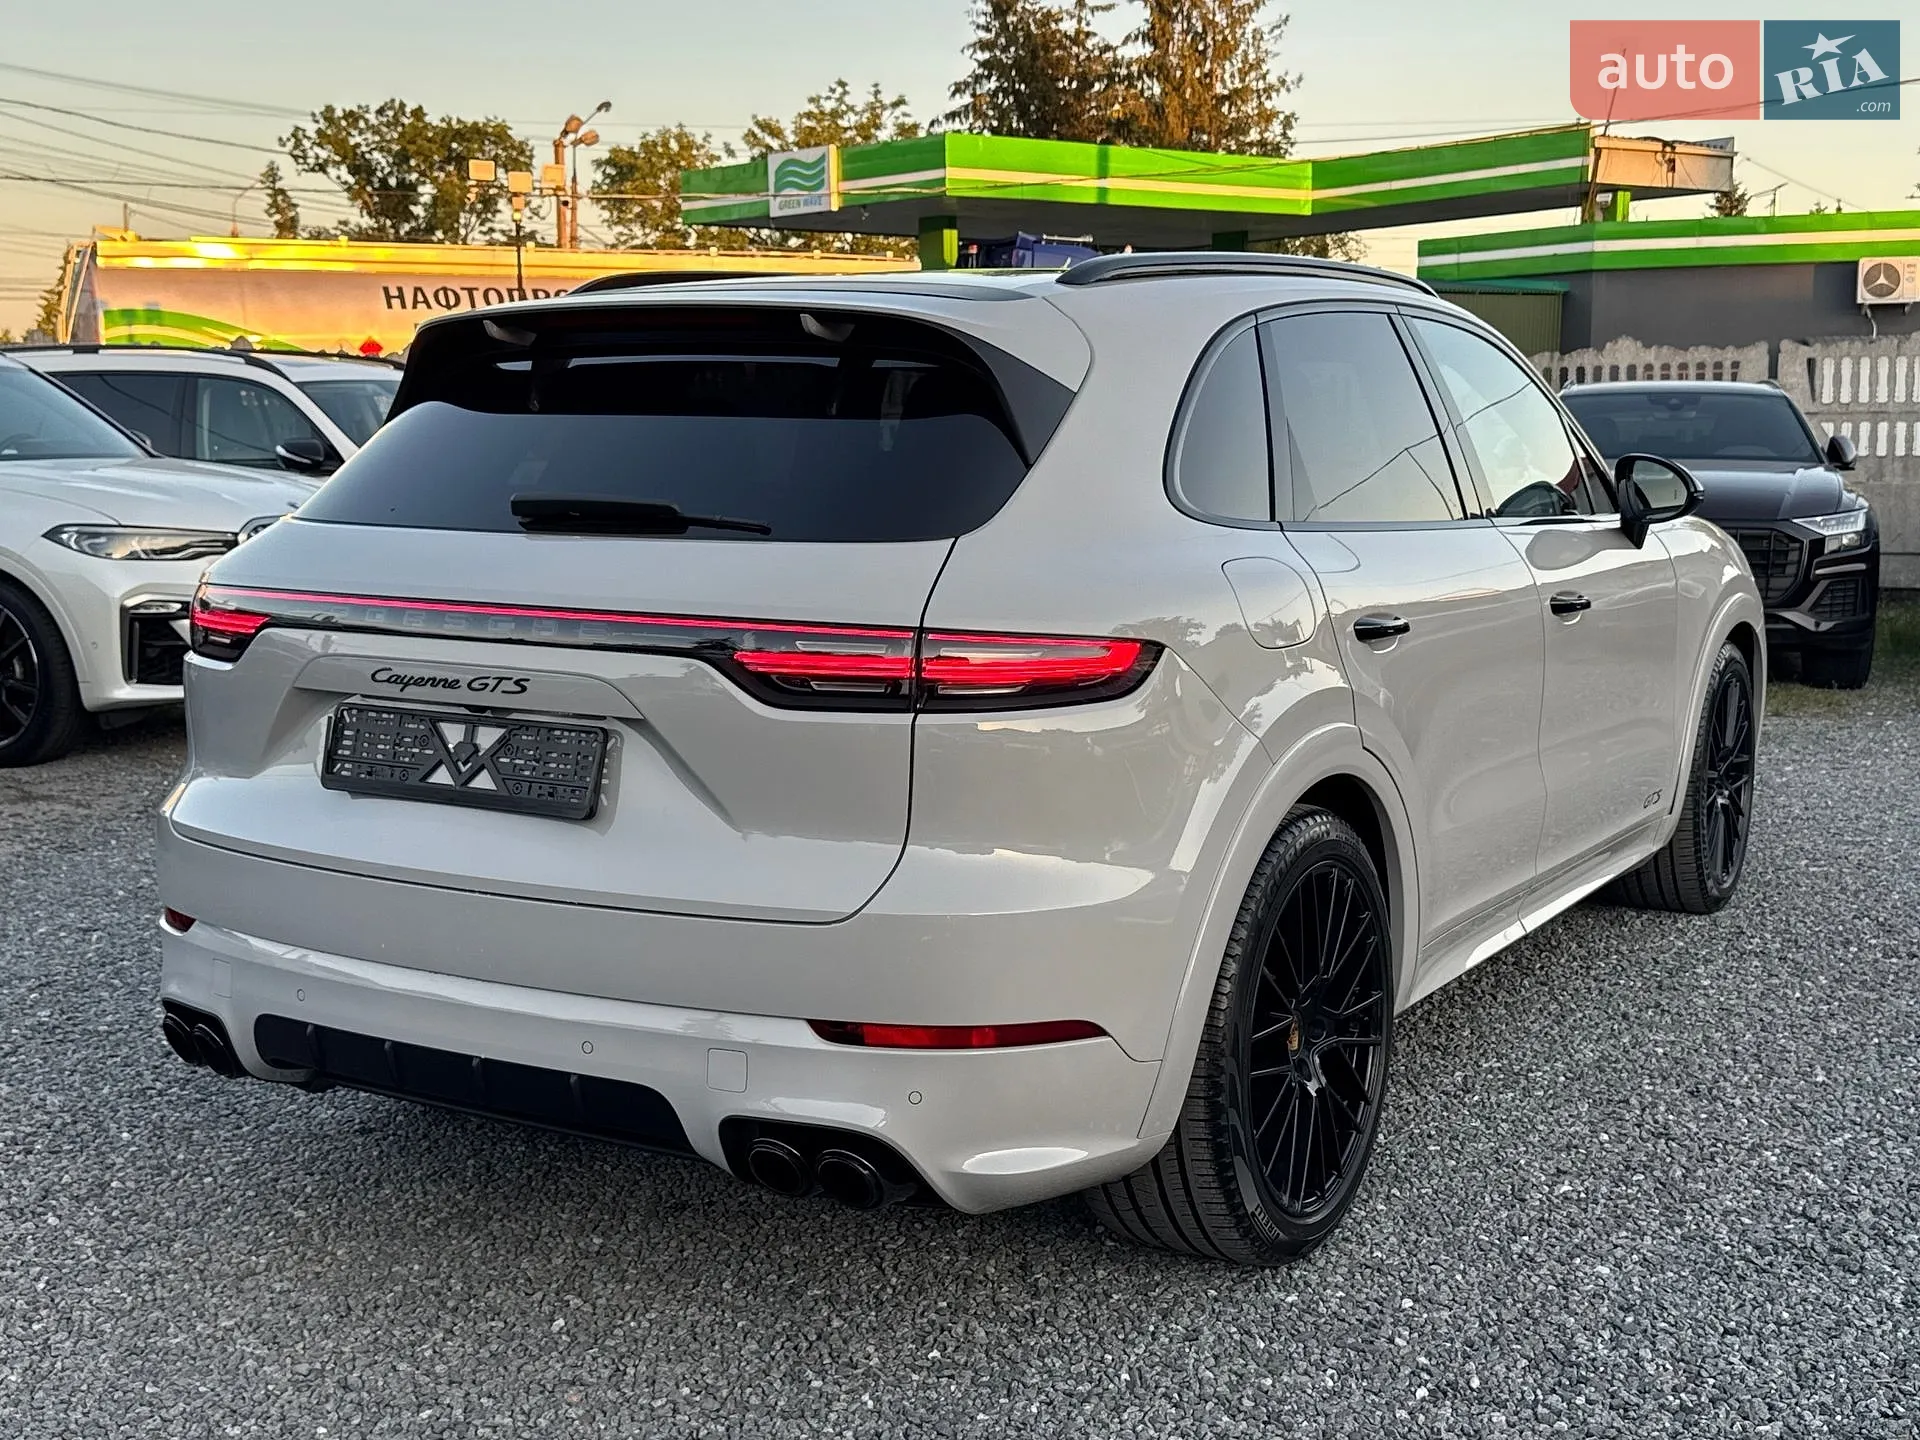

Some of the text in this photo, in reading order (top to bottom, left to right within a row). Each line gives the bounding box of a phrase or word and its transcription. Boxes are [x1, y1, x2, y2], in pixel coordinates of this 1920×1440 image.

[382, 285, 569, 311] НАФТОПР
[371, 667, 531, 695] Cayenne GTS
